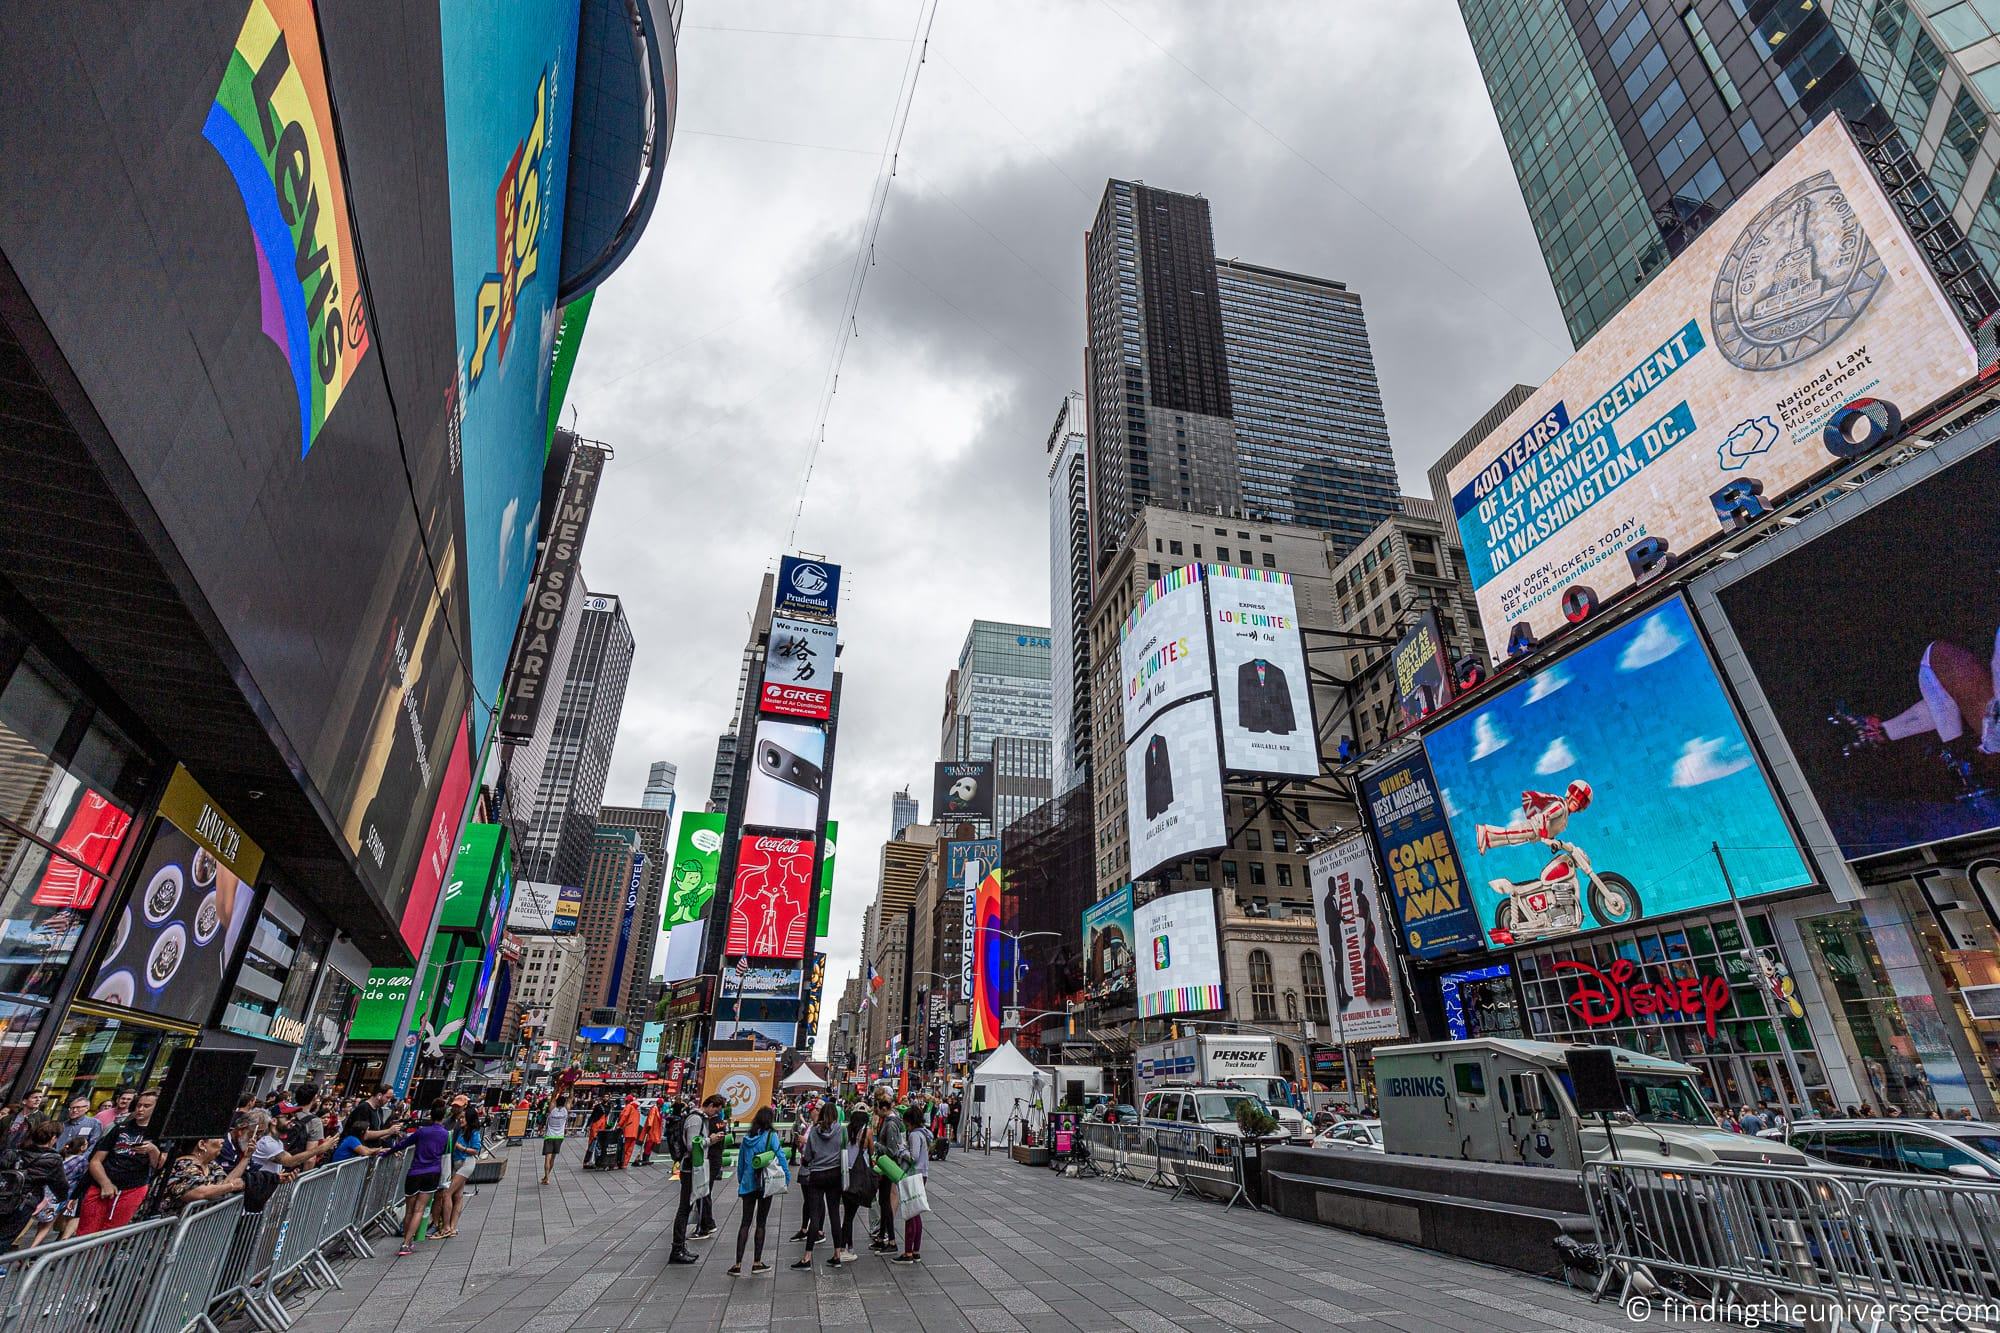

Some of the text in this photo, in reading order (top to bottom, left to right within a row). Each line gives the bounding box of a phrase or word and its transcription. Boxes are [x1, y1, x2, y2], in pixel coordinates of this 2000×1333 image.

[515, 72, 547, 298] TOY
[251, 29, 342, 386] Levi's
[500, 177, 519, 333] STORY
[470, 280, 502, 385] 4
[1776, 345, 1866, 412] National Law
[1781, 355, 1872, 422] Enforcement
[1843, 378, 1880, 404] Solutions
[1478, 330, 1691, 524] OF LAW ENFORCEMENT
[1785, 390, 1844, 432] Museum
[1793, 420, 1829, 446] Foundatio
[1473, 411, 1561, 499] 400 YEARS
[1486, 434, 1610, 549] JUST ARRIVED
[1489, 415, 1687, 575] IN WASHINGTON, DC.
[554, 468, 595, 561] TIMES
[1500, 561, 1554, 604] NOW OPEN!
[1503, 516, 1637, 613] GET YOUR TICKETS TODAY
[1505, 524, 1647, 623] LawEnforcementMuseum.org
[786, 592, 829, 607] Prudential
[1219, 609, 1293, 630] LOVE UNITES
[1238, 602, 1266, 610] EXPRESS
[515, 571, 566, 700] SQUARE
[776, 622, 834, 637] We are Gree
[1396, 637, 1417, 668] ABOUT
[1418, 626, 1428, 642] AS
[1128, 637, 1189, 701] LOVE UNITES
[1397, 647, 1419, 677] GUILTY
[1420, 636, 1430, 653] AS
[1399, 641, 1437, 687] PLEASURES
[509, 712, 529, 722] NYC
[764, 696, 782, 704] Master
[783, 689, 827, 704] GREE
[1251, 742, 1278, 751] AVAILABLE
[944, 766, 984, 774] PHANTOM
[1378, 768, 1413, 797] WINNER!
[1372, 796, 1394, 820] BEST
[1391, 778, 1431, 811] MUSICAL
[1377, 817, 1385, 828] ALL
[1385, 809, 1401, 824] ACROSS
[1401, 804, 1415, 818] NORTH
[1415, 795, 1435, 813] AMERICA
[195, 803, 241, 864] INVICTA
[1165, 815, 1179, 829] NOW
[953, 844, 999, 858] MY FAIR
[1313, 865, 1329, 877] GOOD
[1329, 858, 1343, 872] TIME
[1319, 853, 1334, 866] HAVE
[1338, 842, 1360, 858] REALLY
[1388, 830, 1450, 876] COME
[625, 860, 645, 911] NOVOTEL
[1336, 871, 1357, 925] PRETTY
[1405, 880, 1461, 922] AWAY
[554, 917, 576, 927] FROZEN
[963, 881, 978, 997] COVERGIRL
[1345, 933, 1366, 998] WOMAN
[1212, 1050, 1268, 1061] PENSKE
[1390, 1076, 1446, 1098] BRINKS
[1539, 1135, 1548, 1147] B
